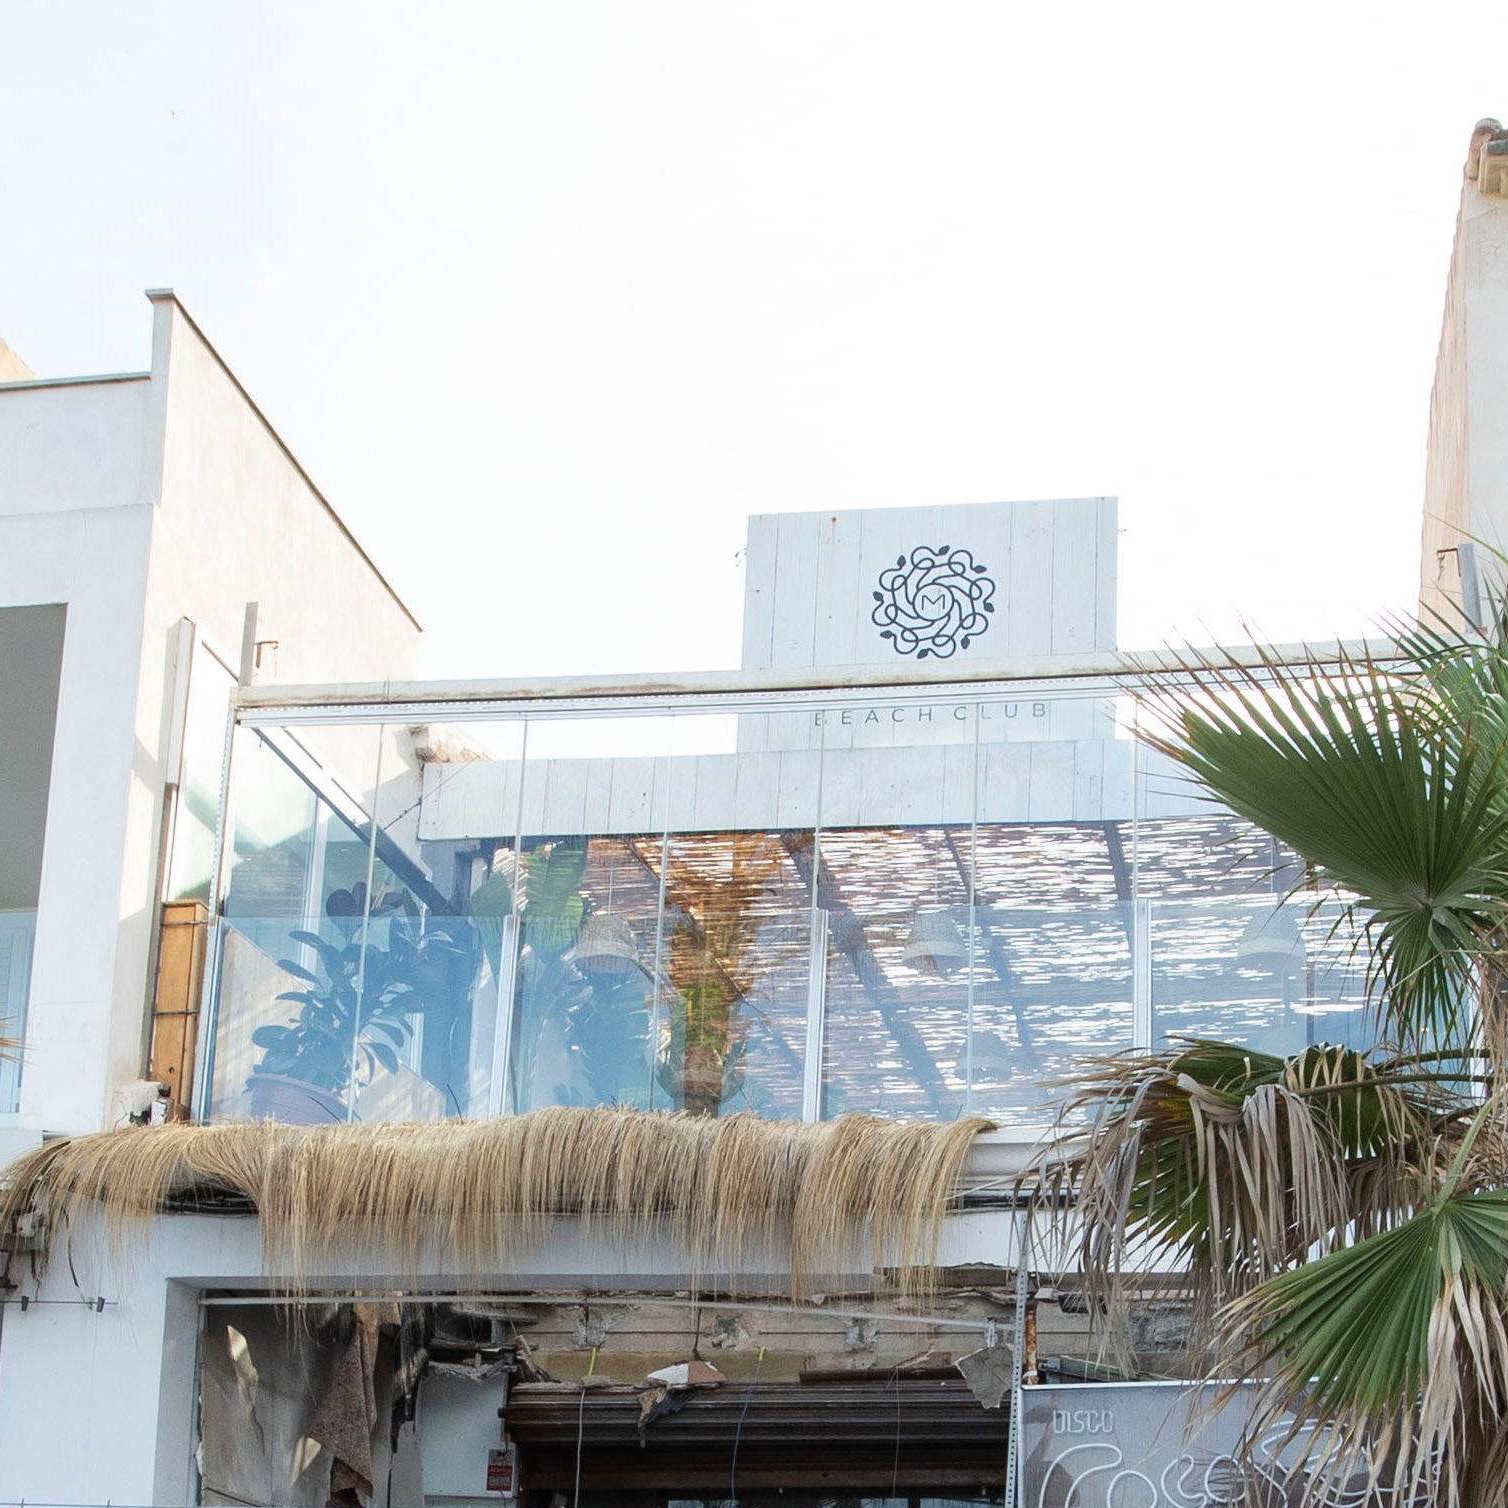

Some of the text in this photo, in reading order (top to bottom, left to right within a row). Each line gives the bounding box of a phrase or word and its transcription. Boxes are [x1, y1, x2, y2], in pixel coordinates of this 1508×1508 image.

[920, 594, 946, 611] M
[814, 703, 1047, 727] BEACH CLUB
[1053, 1409, 1114, 1435] DISCO
